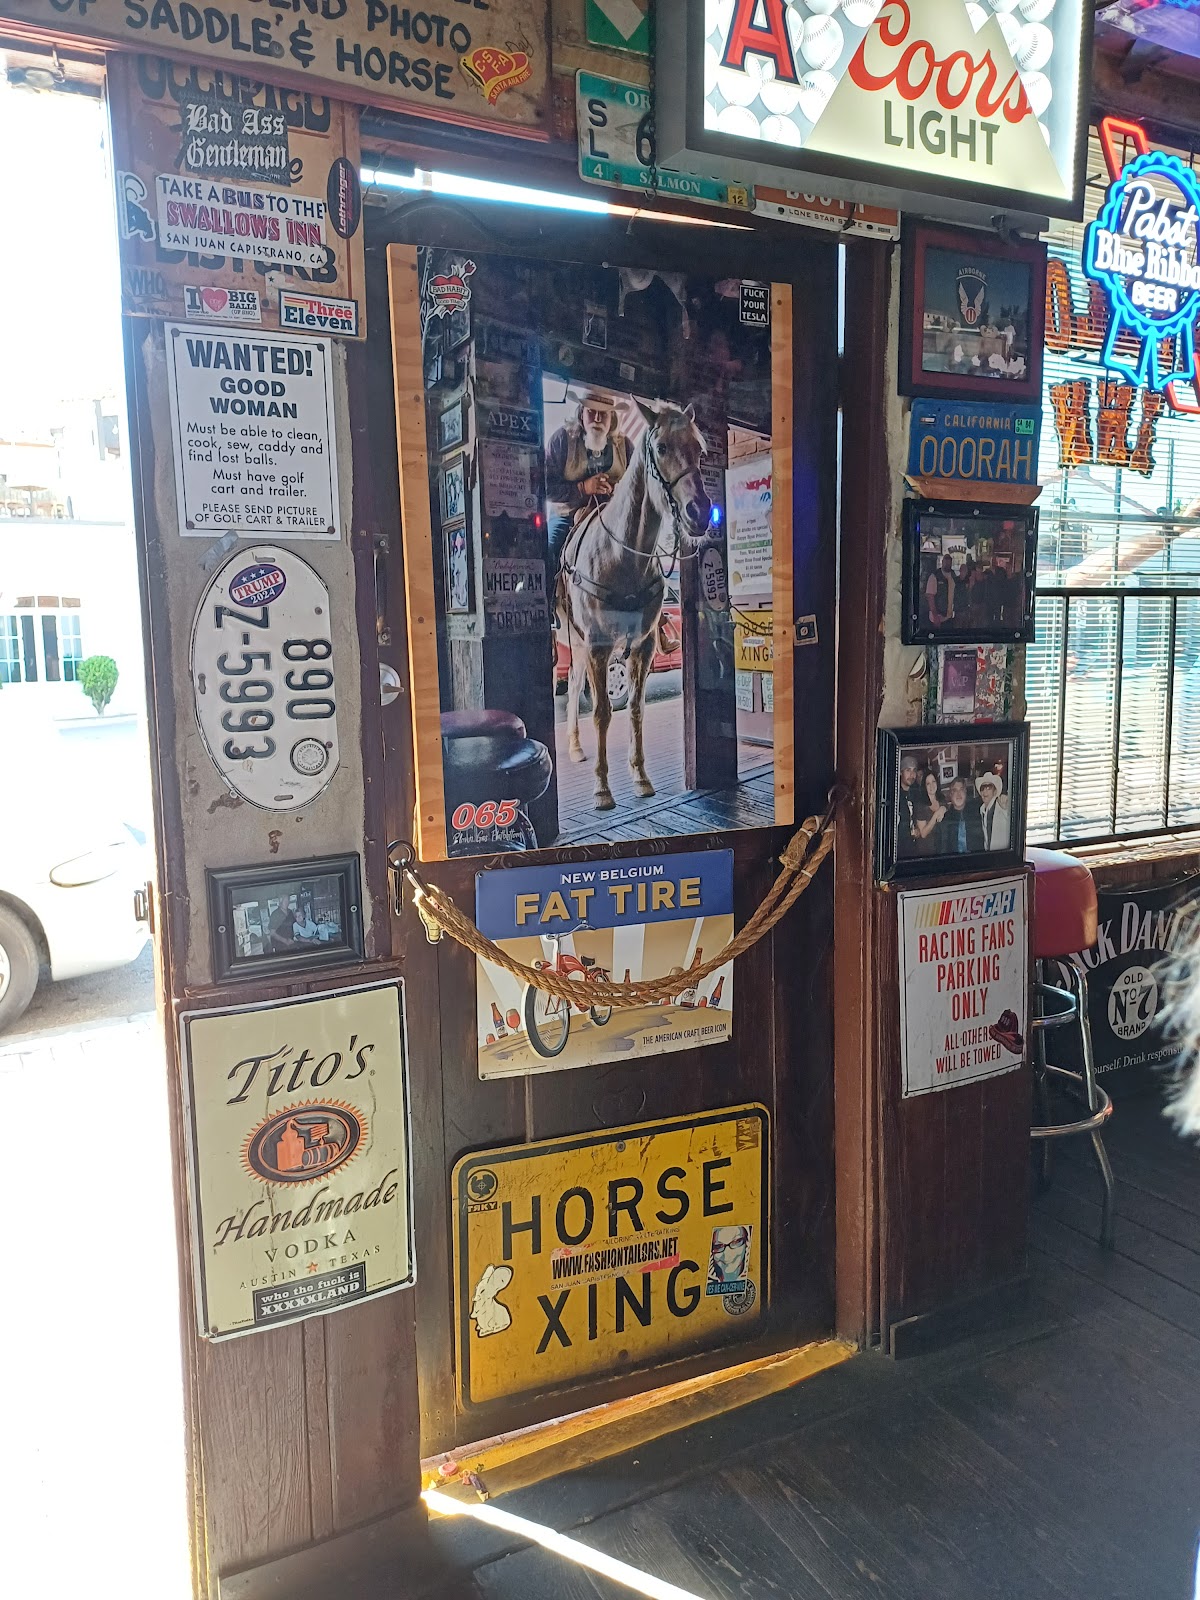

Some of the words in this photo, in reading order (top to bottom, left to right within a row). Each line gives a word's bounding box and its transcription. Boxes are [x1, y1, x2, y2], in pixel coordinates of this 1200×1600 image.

[365, 0, 471, 54] PHOTO
[719, 0, 804, 88] A
[289, 20, 315, 68] &
[336, 38, 455, 99] HORSE
[847, 0, 1034, 124] Coors
[490, 81, 508, 99] SANTA
[507, 76, 520, 87] ANA
[519, 69, 531, 82] FIRE
[804, 80, 816, 90] TM
[186, 103, 233, 136] Bad
[241, 108, 286, 136] Ass
[884, 99, 1001, 166] LIGHT
[186, 136, 287, 171] Gentleman
[593, 163, 603, 178] 4
[159, 176, 202, 200] TAKE
[207, 186, 221, 203] A
[222, 187, 265, 211] BUS
[266, 192, 289, 213] TO
[292, 199, 325, 220] THE
[732, 195, 744, 206] 12
[166, 200, 280, 241] SWALLOWS
[285, 217, 323, 248] INN
[789, 208, 811, 218] LONE
[814, 213, 835, 224] STAR
[1122, 180, 1199, 248] Pabst
[167, 232, 190, 246] SAN
[194, 237, 225, 250] JUAN
[230, 242, 305, 263] CAPISTRANO,
[310, 252, 323, 265] CA
[1095, 228, 1146, 276] Blue
[958, 267, 987, 281] AIRBORNE
[186, 288, 201, 310] I
[228, 290, 257, 303] BIG
[446, 285, 467, 295] HABIT
[743, 288, 765, 299] FUCK
[743, 300, 766, 310] YOUR
[1131, 281, 1178, 313] BEER
[228, 301, 257, 310] BALLS
[284, 306, 353, 331] Eleven
[306, 300, 353, 319] Three
[742, 311, 767, 322] TESLA
[185, 338, 313, 377] WANTED!
[220, 377, 286, 397] GOOD
[209, 396, 298, 419] WOMAN
[486, 411, 531, 431] APEX
[944, 414, 1011, 431] CALIFORNIA
[186, 422, 216, 435] Must
[220, 422, 236, 436] be
[240, 424, 268, 438] able
[271, 428, 284, 439] to
[287, 428, 322, 443] clean,
[188, 436, 222, 451] cook,
[227, 441, 253, 452] sew,
[258, 440, 296, 456] caddy
[301, 442, 323, 454] and
[188, 449, 213, 462] find
[218, 450, 240, 464] lost
[244, 452, 278, 466] balls.
[919, 434, 1033, 481] OOORAH
[211, 483, 235, 495] cart
[240, 484, 264, 496] and
[269, 484, 307, 498] trailer.
[213, 468, 242, 481] Must
[247, 470, 276, 482] have
[281, 472, 305, 486] golf
[195, 513, 210, 523] OF
[214, 514, 242, 524] GOLF
[246, 515, 272, 525] CART
[276, 516, 283, 526] &
[286, 516, 326, 527] TRAILER
[202, 503, 241, 514] PLEASE
[244, 504, 274, 515] SEND
[277, 506, 318, 516] PICTURE
[233, 571, 281, 601] TRUMP
[704, 562, 717, 601] Z-5993
[715, 568, 725, 590] 890
[250, 587, 276, 605] 2024
[741, 647, 769, 662] XING
[214, 606, 277, 761] Z-5993
[282, 639, 336, 721] 890
[452, 799, 520, 830] 065
[561, 872, 596, 885] NEW
[600, 865, 664, 881] BELGIUM
[515, 887, 595, 926] FAT
[608, 877, 702, 915] TIRE
[950, 889, 1014, 924] NASCAR
[919, 927, 976, 963] RACING
[982, 919, 1015, 953] FANS
[937, 953, 1000, 992] PARKING
[1124, 972, 1144, 985] OLD
[952, 987, 989, 1021] ONLY
[1137, 984, 1154, 1015] 7
[643, 1035, 654, 1045] THE
[655, 1030, 683, 1044] AMERICAN
[683, 1027, 700, 1040] CRAFT
[701, 1026, 715, 1037] BEER
[715, 1023, 727, 1034] ICON
[944, 1033, 959, 1052] ALL
[1117, 1021, 1146, 1036] BRAND
[226, 1034, 375, 1106] Tito's
[936, 1056, 957, 1074] WILL
[960, 1052, 971, 1069] BE
[973, 1043, 1001, 1064] TOWED
[1094, 1058, 1121, 1075] ourself.
[1122, 1052, 1146, 1067] Drink
[213, 1168, 398, 1249] Handmade
[501, 1157, 734, 1261] HORSE
[264, 1229, 357, 1263] VODKA
[552, 1237, 679, 1280] WWW.FASHIONTAILORS.NET
[240, 1269, 296, 1290] AUSTIN
[329, 1245, 381, 1267] TEXAS
[261, 1291, 289, 1303] who
[293, 1284, 314, 1296] the
[317, 1276, 346, 1290] fuck
[349, 1271, 360, 1280] is
[535, 1260, 701, 1355] XING
